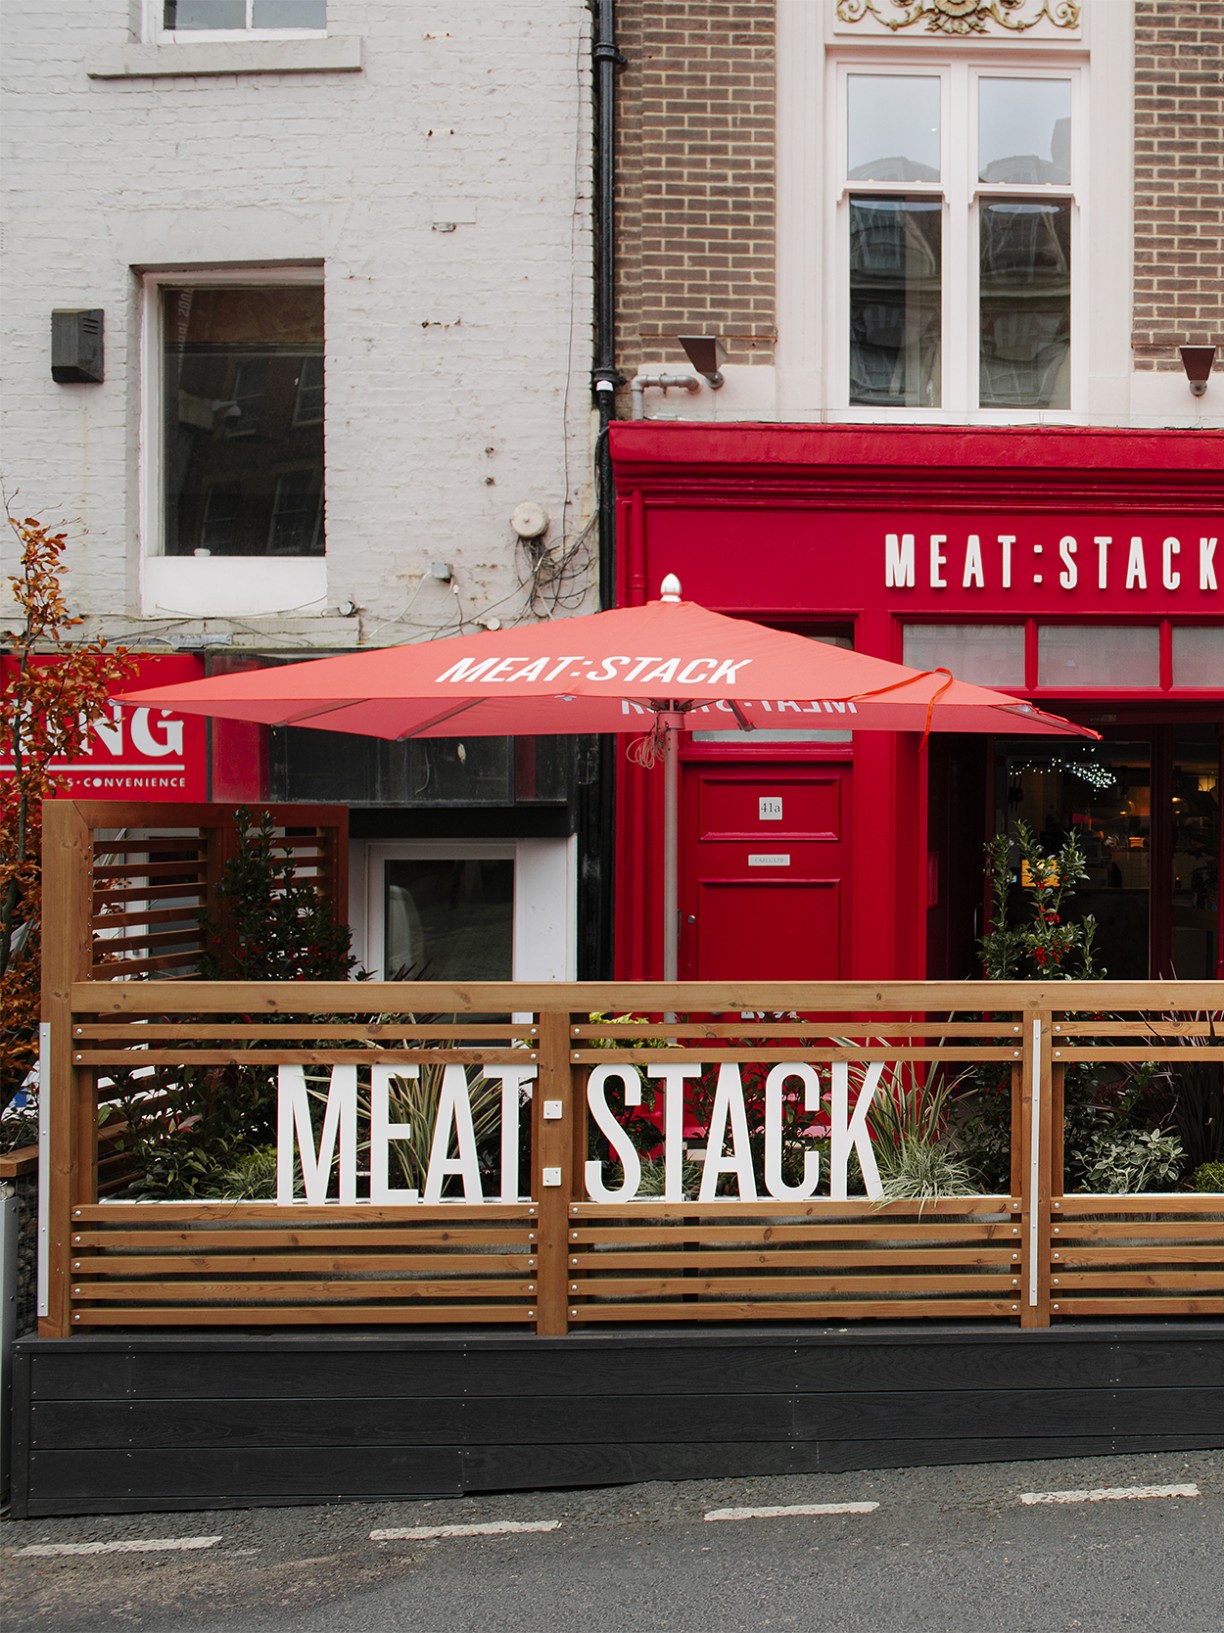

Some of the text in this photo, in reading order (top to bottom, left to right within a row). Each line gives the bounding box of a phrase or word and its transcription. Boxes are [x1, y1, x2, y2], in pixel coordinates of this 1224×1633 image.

[885, 533, 1219, 591] MEAT:STACK
[435, 655, 754, 685] MEAT:STACK
[761, 802, 781, 813] 41a
[277, 1062, 886, 1206] MEAT:STACK
